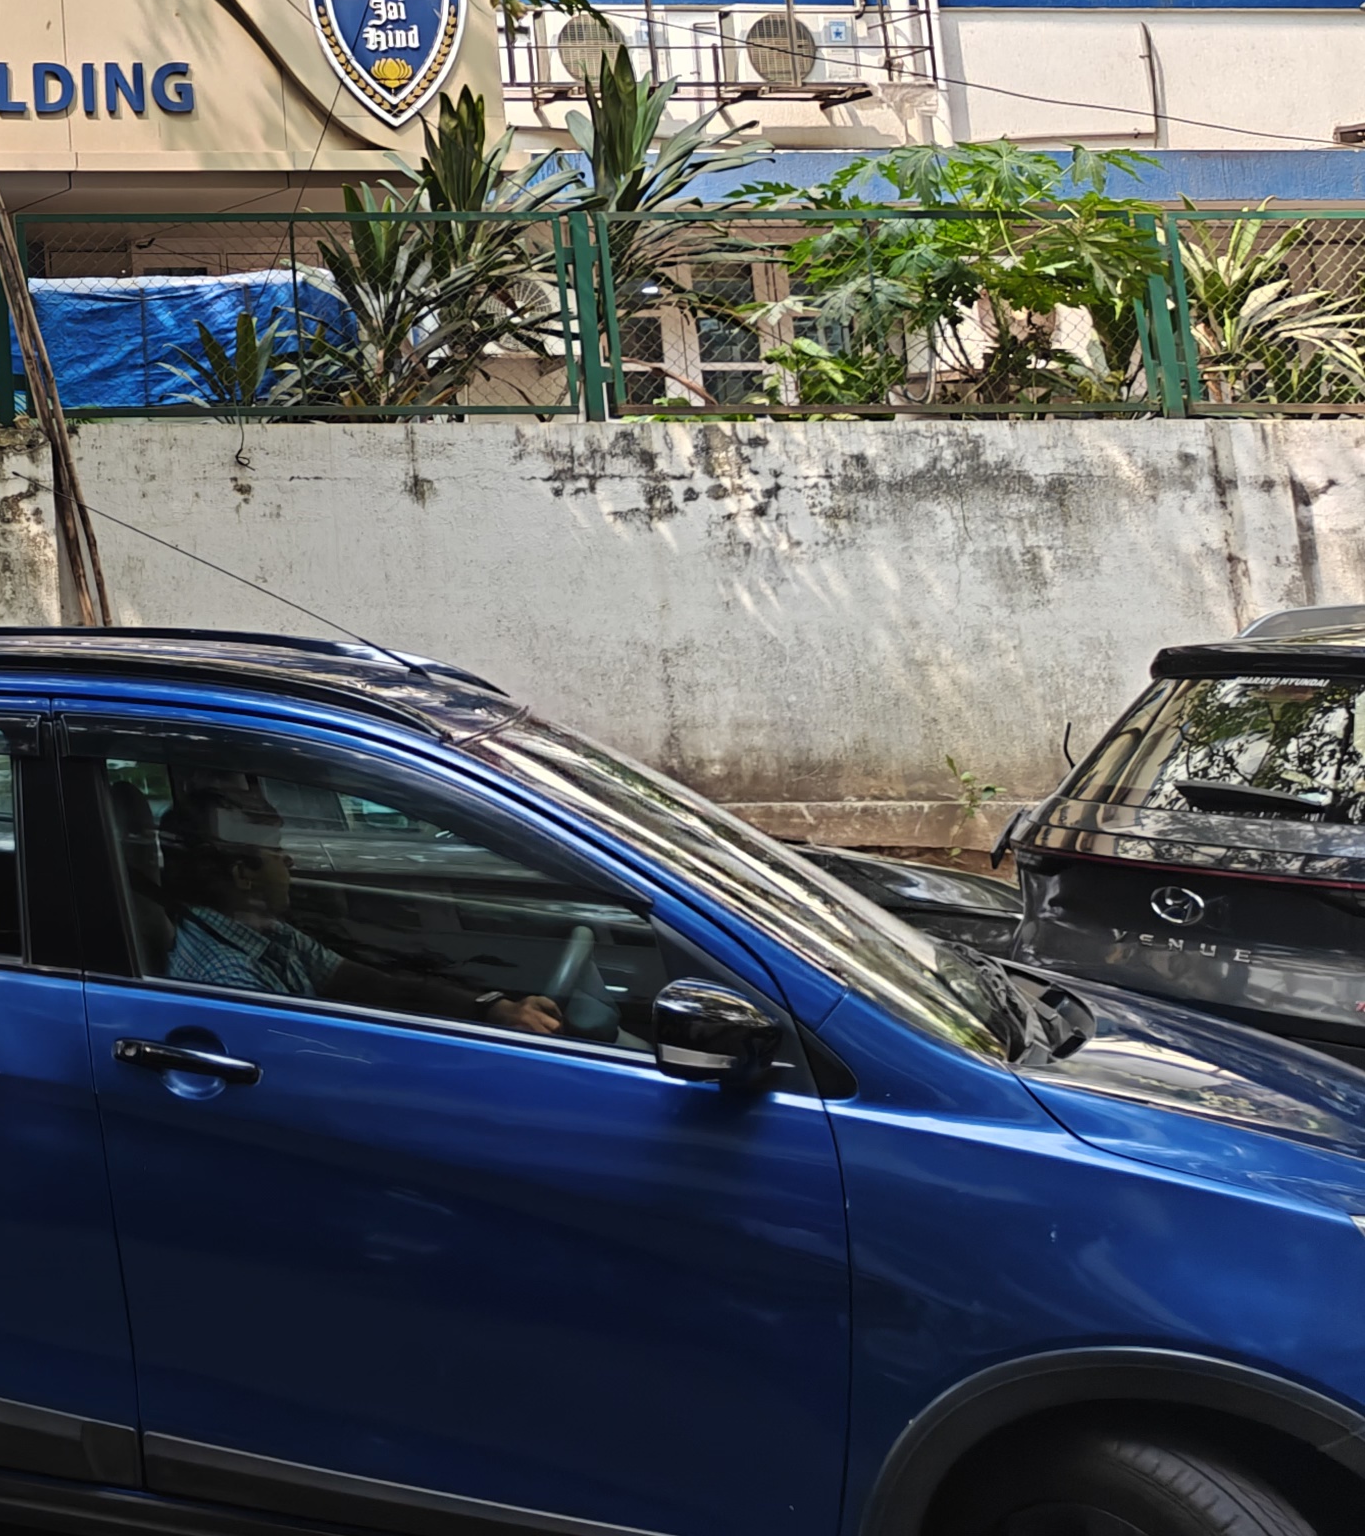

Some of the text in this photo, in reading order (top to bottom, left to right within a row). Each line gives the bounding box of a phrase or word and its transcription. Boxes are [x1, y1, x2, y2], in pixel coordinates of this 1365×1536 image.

[362, 24, 421, 51] Hind
[1279, 677, 1330, 687] HYUNDAI
[1111, 928, 1252, 963] VENUE
